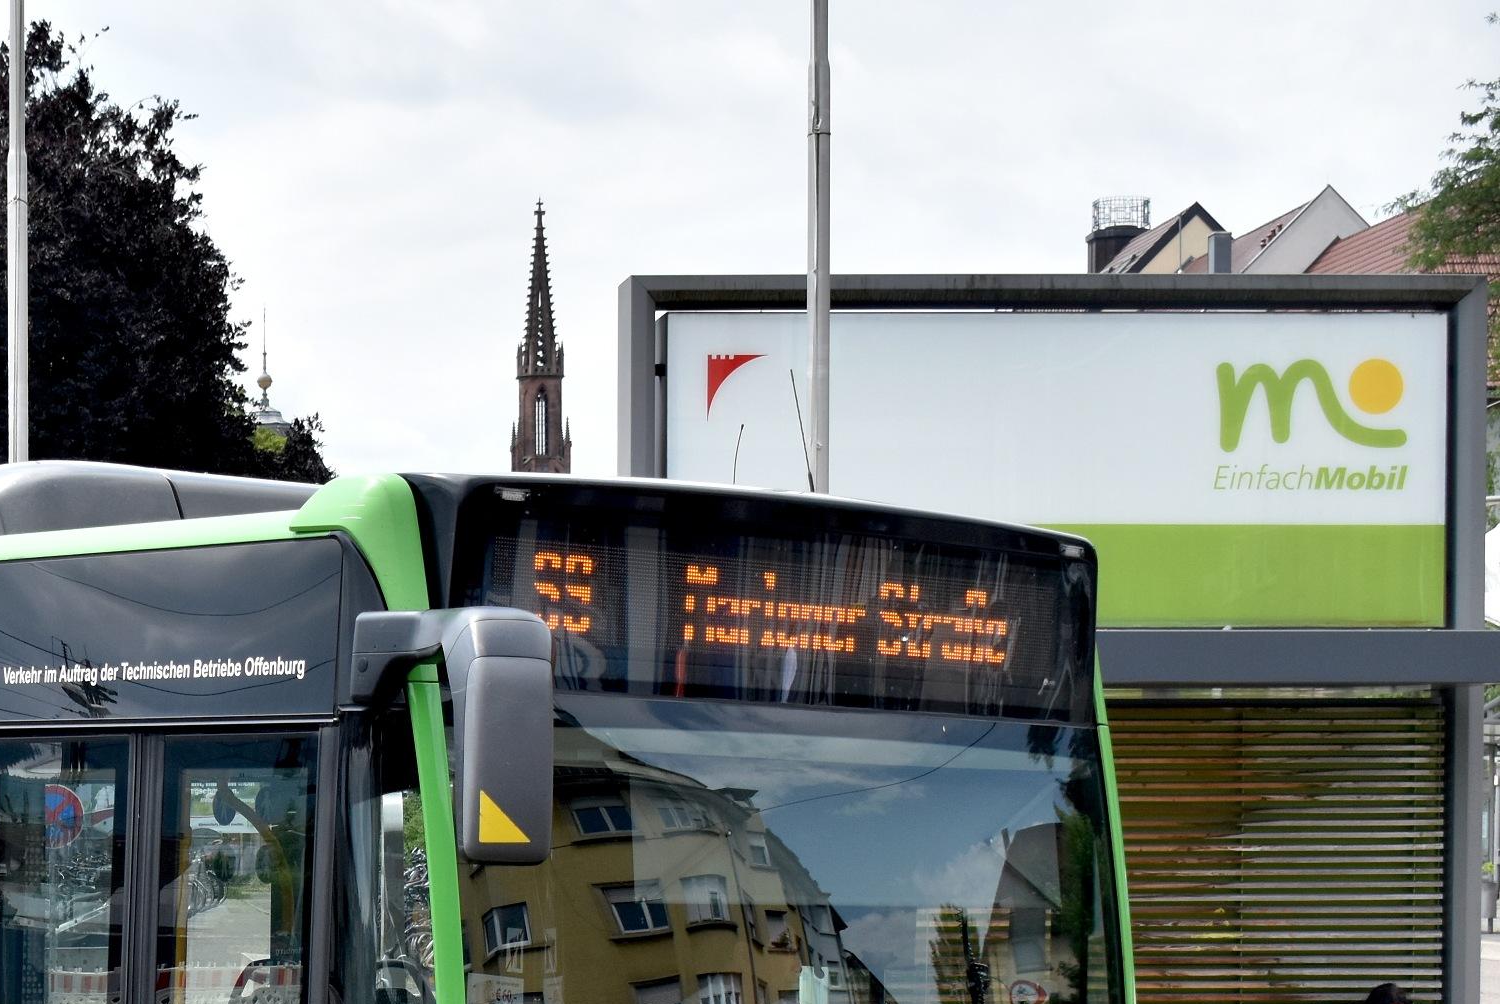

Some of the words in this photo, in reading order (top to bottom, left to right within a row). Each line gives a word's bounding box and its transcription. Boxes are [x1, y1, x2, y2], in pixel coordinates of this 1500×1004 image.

[1213, 464, 1408, 491] EinfachMobil
[3, 666, 42, 685] Verkehr
[44, 665, 56, 683] im
[59, 664, 98, 687] Auftrag
[101, 663, 119, 681] der
[121, 661, 190, 681] Technischen
[193, 658, 242, 678] Betriebe
[244, 656, 306, 680] Offenburg
